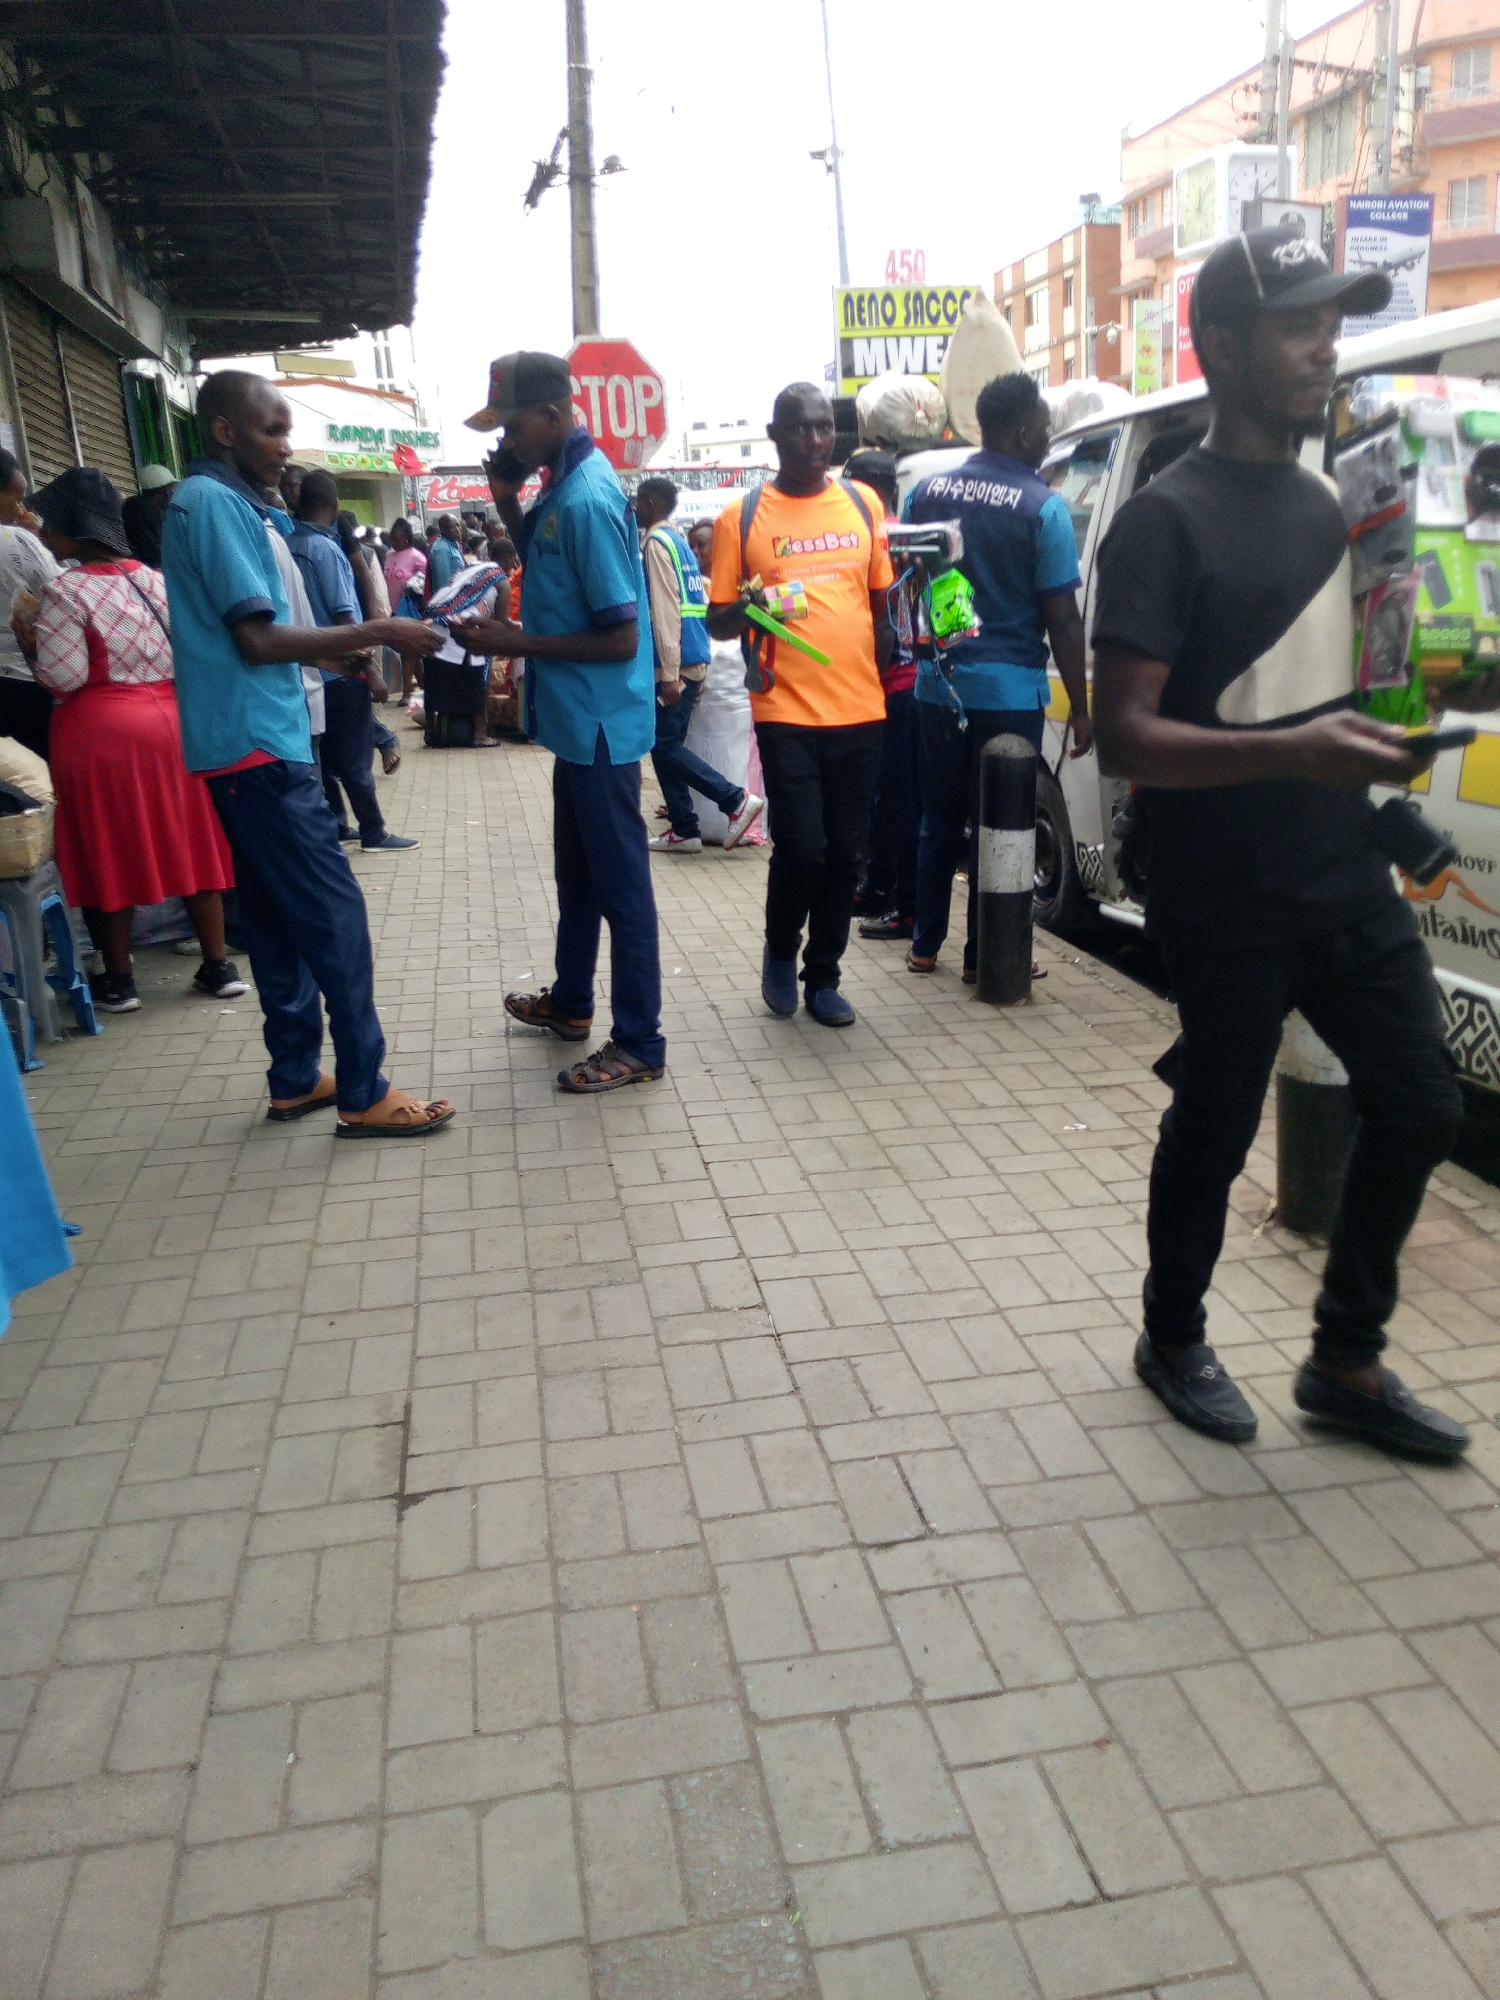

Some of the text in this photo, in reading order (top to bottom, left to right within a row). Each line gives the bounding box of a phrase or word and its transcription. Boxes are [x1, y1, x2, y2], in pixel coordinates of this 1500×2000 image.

[1350, 200, 1430, 210] NAIROBI AVIATION
[1370, 211, 1408, 221] COLLEGE
[885, 249, 926, 285] 450
[843, 291, 897, 328] NENO
[853, 336, 953, 376] MWE
[327, 423, 440, 448] RANDA DISHES
